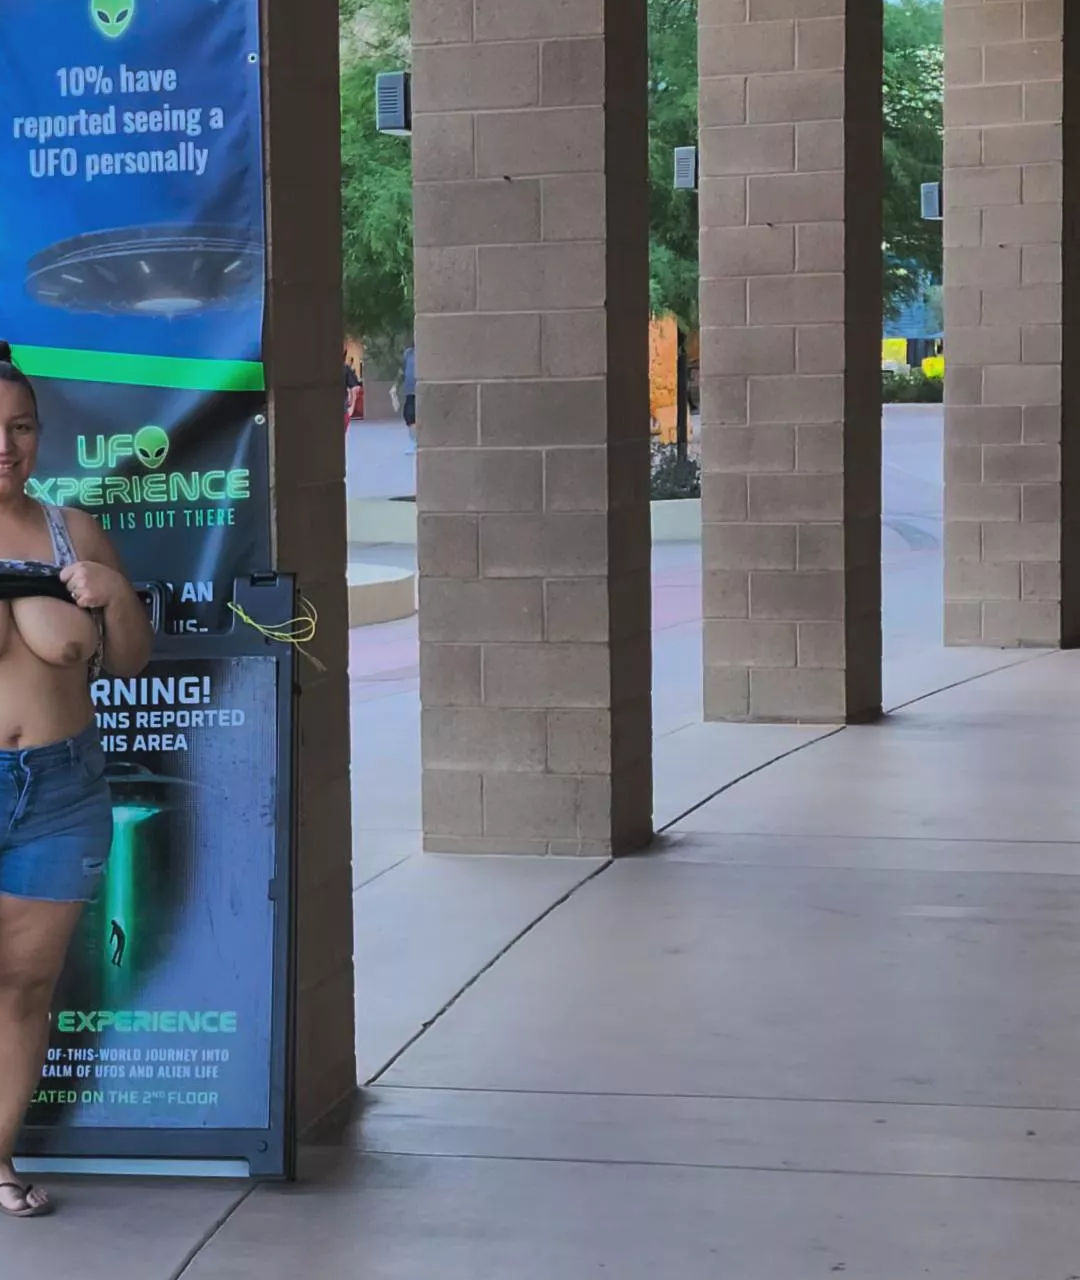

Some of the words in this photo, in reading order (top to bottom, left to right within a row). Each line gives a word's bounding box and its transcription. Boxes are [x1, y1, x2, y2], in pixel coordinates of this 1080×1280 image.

[56, 65, 113, 96] 10%
[120, 64, 177, 93] have
[13, 105, 116, 143] reported
[123, 103, 202, 136] seeing
[209, 106, 224, 129] a
[29, 147, 77, 178] UFO
[86, 141, 209, 182] personally
[25, 469, 250, 506] XPERIENCE
[120, 512, 135, 529] IS
[145, 511, 175, 528] OUT
[184, 508, 236, 527] THERE
[181, 581, 214, 602] AN
[90, 676, 210, 706] RNING!
[136, 709, 245, 728] REPORTED
[133, 734, 188, 751] AREA
[58, 1010, 237, 1033] EXPERIENCE
[47, 1048, 141, 1061] OF-THIS-WORLD
[145, 1048, 198, 1062] JOURNEY
[201, 1048, 230, 1062] INTO
[42, 1064, 72, 1077] EALM
[76, 1064, 91, 1077] OF
[129, 1064, 154, 1078] AND
[157, 1065, 191, 1079] ALIEN
[195, 1065, 219, 1079] LIFE
[81, 1089, 104, 1104] ON
[108, 1089, 139, 1104] THE
[168, 1091, 218, 1105] FLOOR
